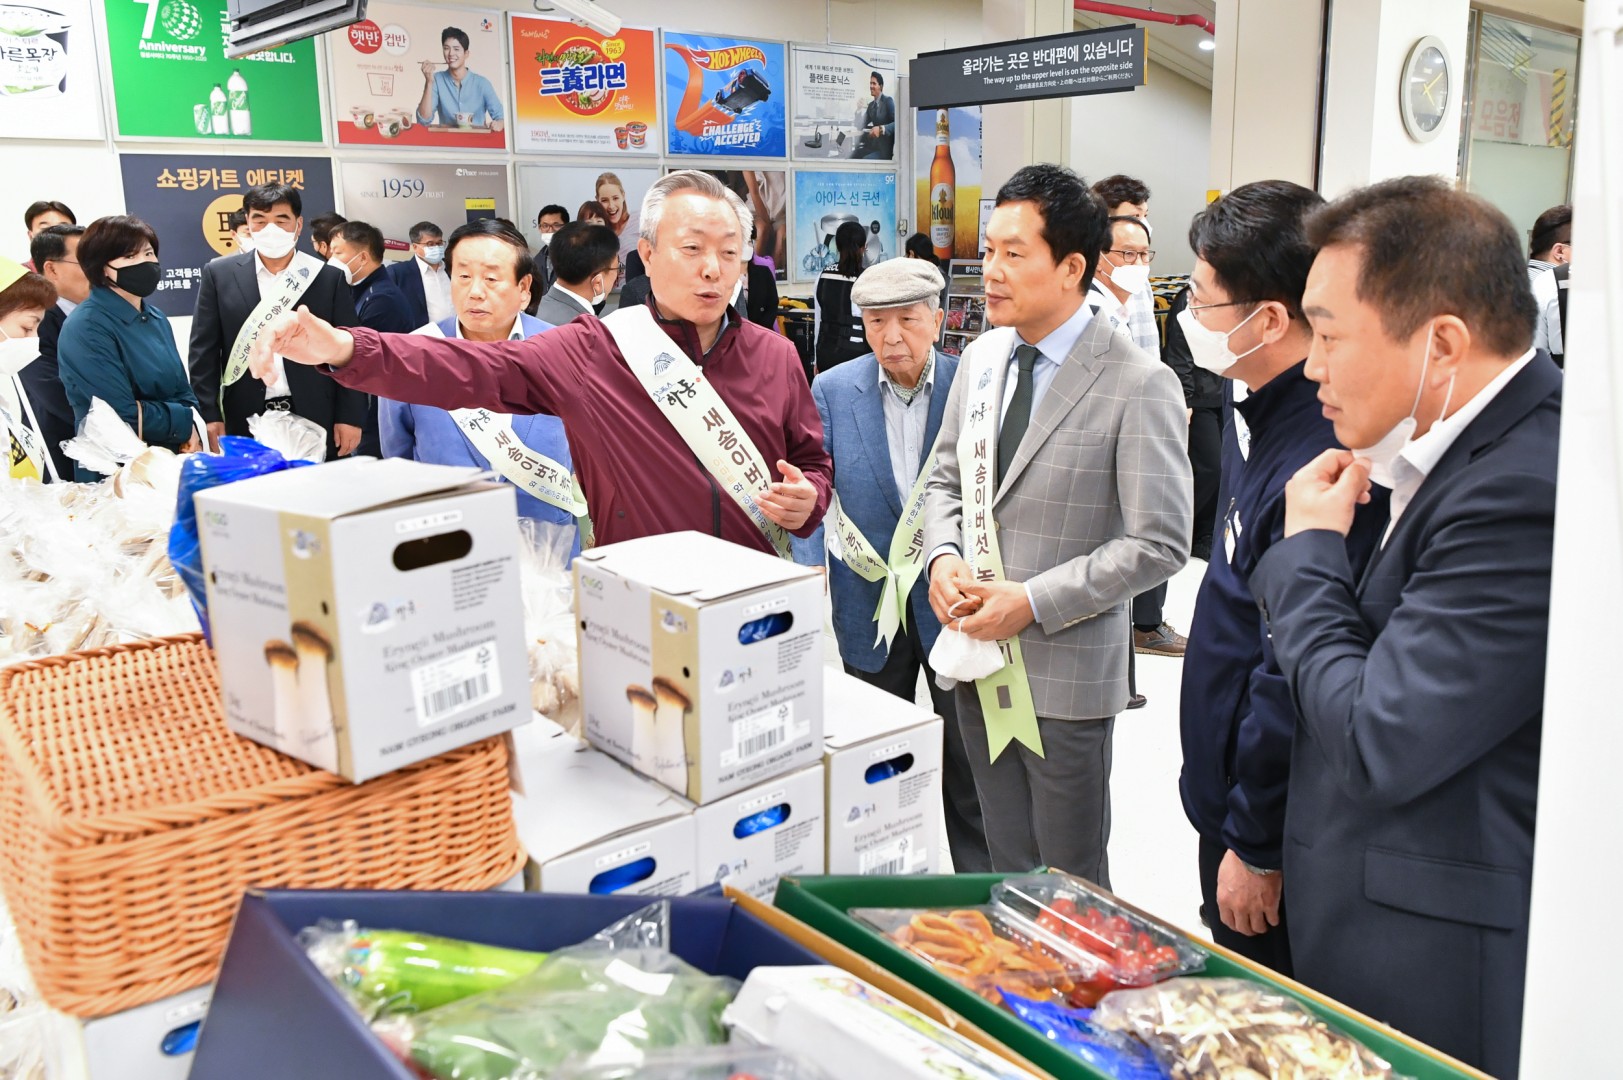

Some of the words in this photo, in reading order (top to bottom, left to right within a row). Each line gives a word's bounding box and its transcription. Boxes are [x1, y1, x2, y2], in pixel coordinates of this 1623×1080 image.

[138, 39, 206, 57] Anniversary
[350, 29, 380, 48] 햇반
[384, 33, 407, 48] 컵반
[605, 47, 622, 55] 1963
[961, 55, 1004, 76] 올라가는
[1006, 51, 1030, 71] 곳은
[1032, 45, 1079, 67] 반대편에
[1082, 37, 1134, 61] 있습니다
[809, 72, 851, 85] 플랜트로닉스
[983, 76, 994, 85] The
[994, 76, 1005, 86] way
[1006, 74, 1014, 84] up
[1014, 73, 1020, 82] to
[1021, 71, 1031, 81] the
[1031, 69, 1049, 81] upper
[1050, 67, 1064, 78] level
[1065, 67, 1069, 76] is
[1070, 67, 1078, 76] on
[1079, 64, 1090, 75] the
[1091, 61, 1119, 75] opposite
[1119, 60, 1133, 72] side
[702, 121, 755, 137] CHALLENGE
[713, 132, 761, 147] ACCEPTED
[156, 167, 241, 191] 쇼핑카트
[246, 168, 305, 190] 에티켓
[381, 178, 425, 198] 1959
[425, 191, 445, 199] TRUST
[815, 190, 847, 206] 아이스
[849, 190, 859, 207] 선
[862, 191, 880, 207] 쿠션
[931, 204, 954, 221] Kloud
[165, 267, 202, 279] 고객들의
[666, 378, 698, 410] 하동
[494, 430, 559, 484] 새송이버섯
[973, 438, 991, 556] 새송이버섯
[432, 617, 497, 645] Mushroom
[760, 679, 806, 700] Mushroom
